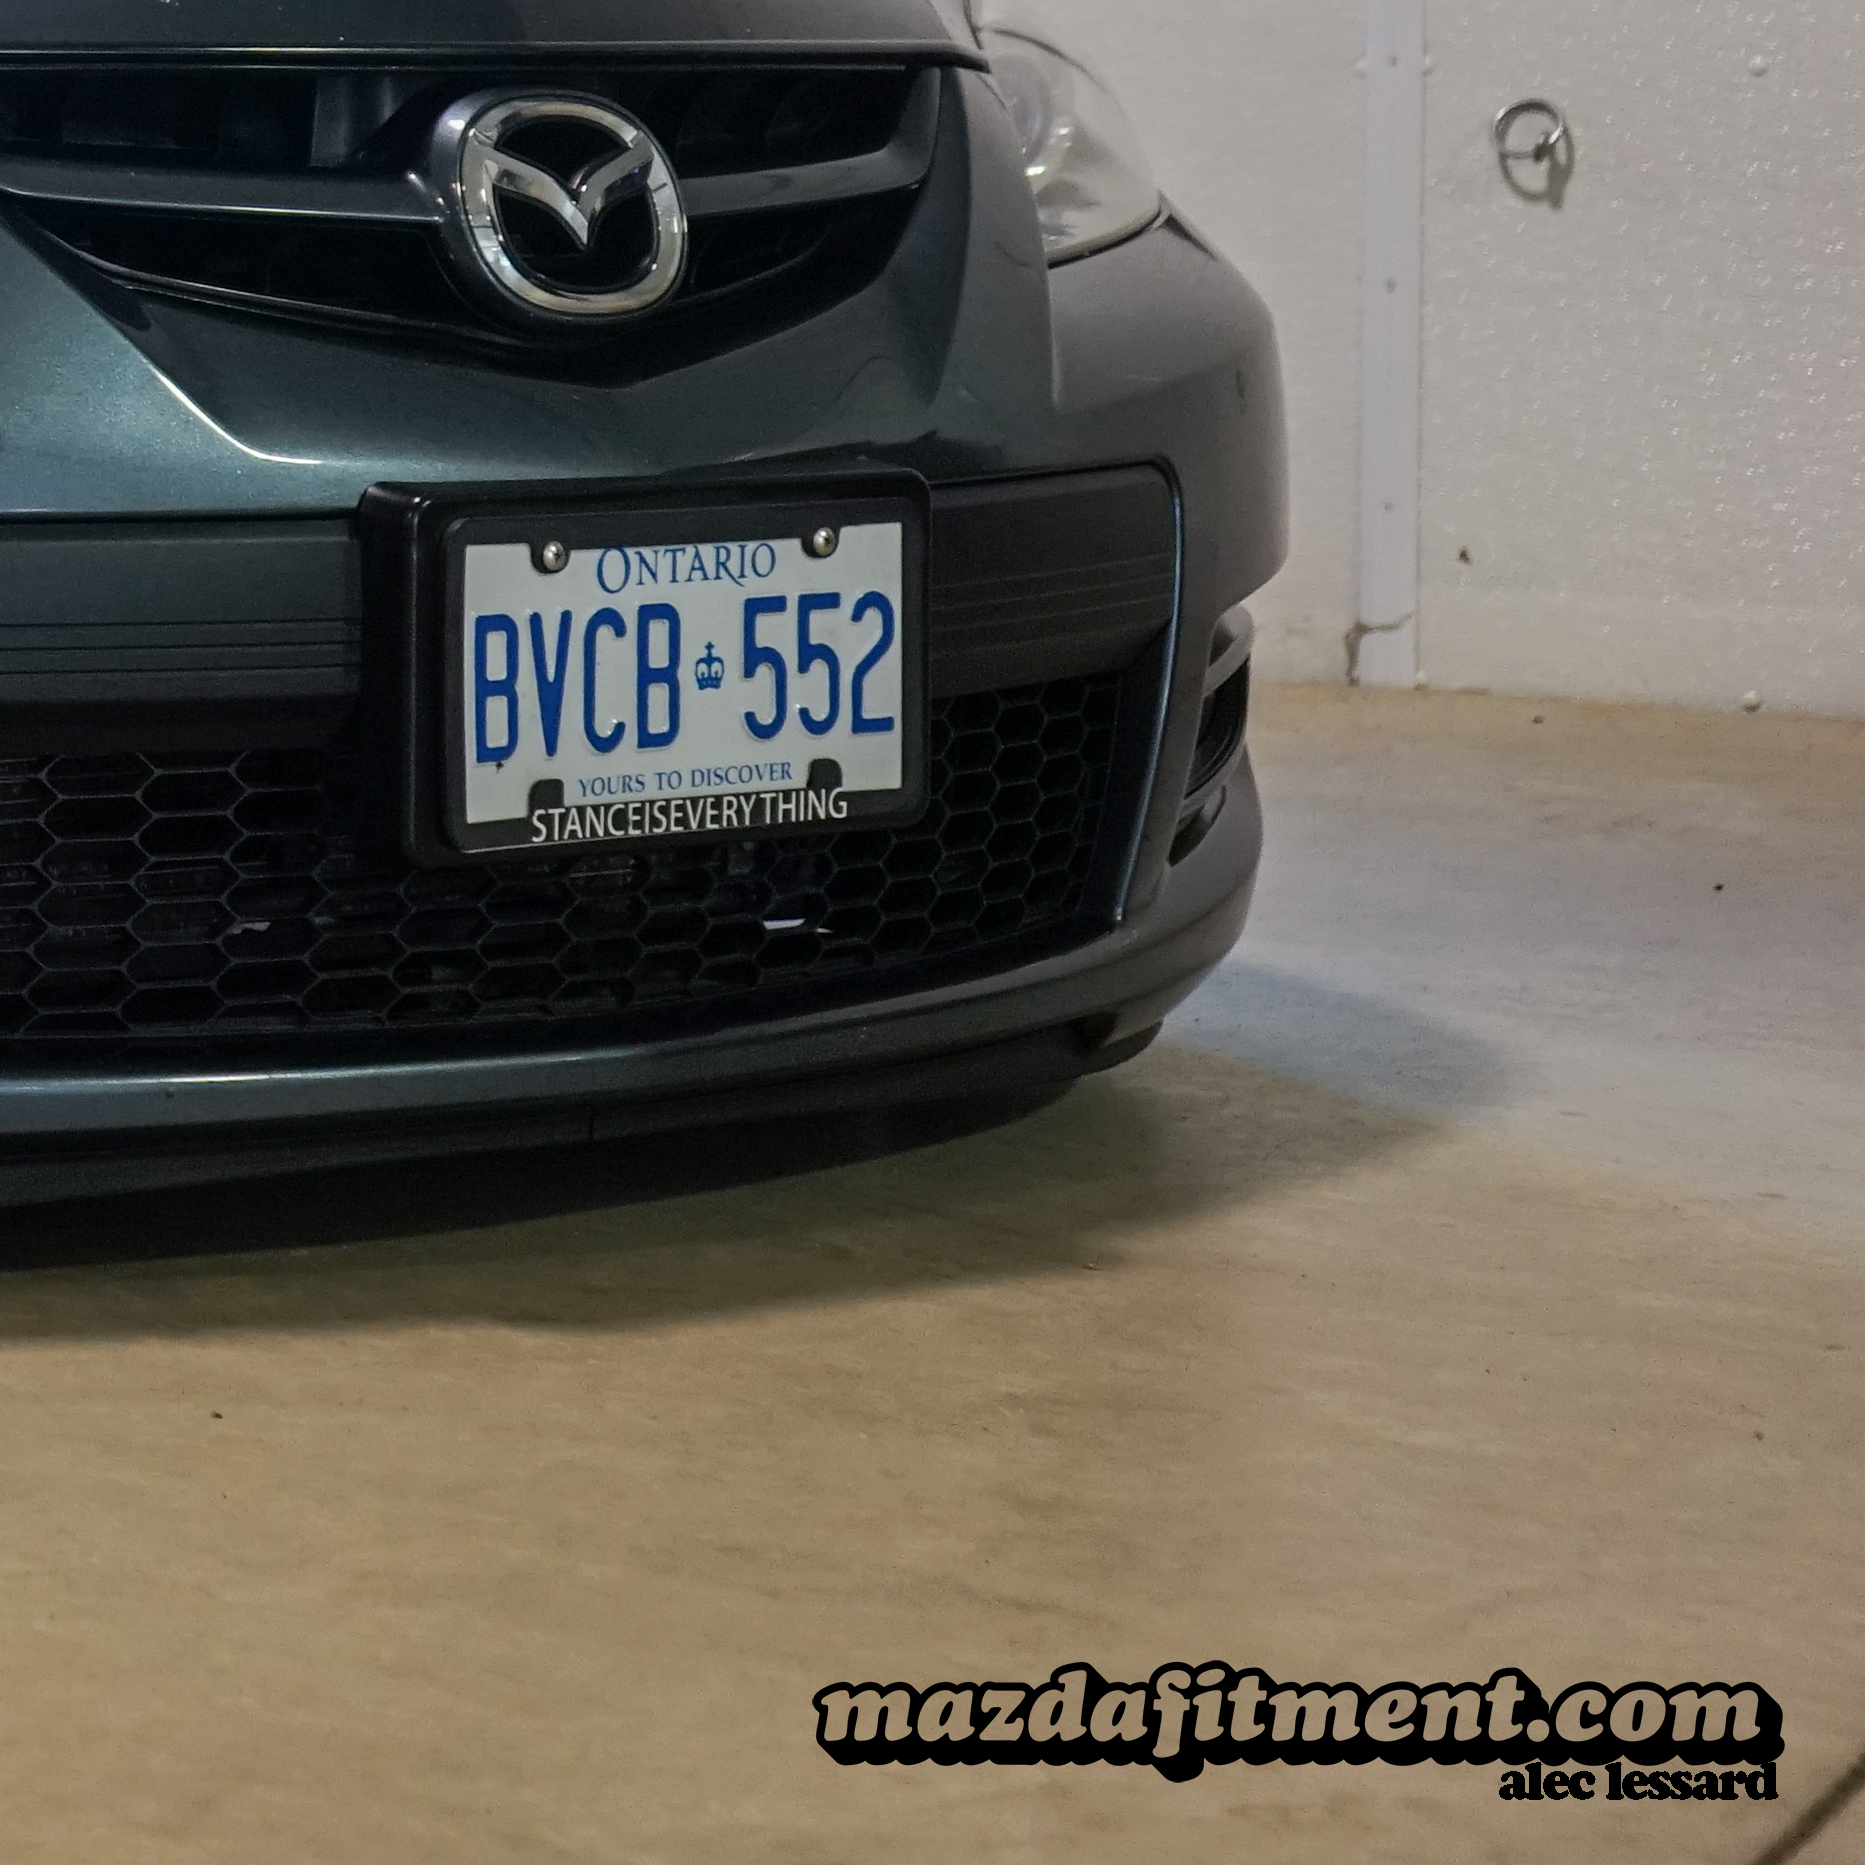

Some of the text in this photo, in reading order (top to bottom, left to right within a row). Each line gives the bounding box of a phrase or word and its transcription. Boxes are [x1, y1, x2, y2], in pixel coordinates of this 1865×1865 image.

[596, 542, 777, 594] ONTARIO
[474, 590, 897, 765] BVCB 552
[578, 761, 793, 798] YOURS TO DISCOVER
[531, 786, 849, 843] STANCEISEVERYTHING
